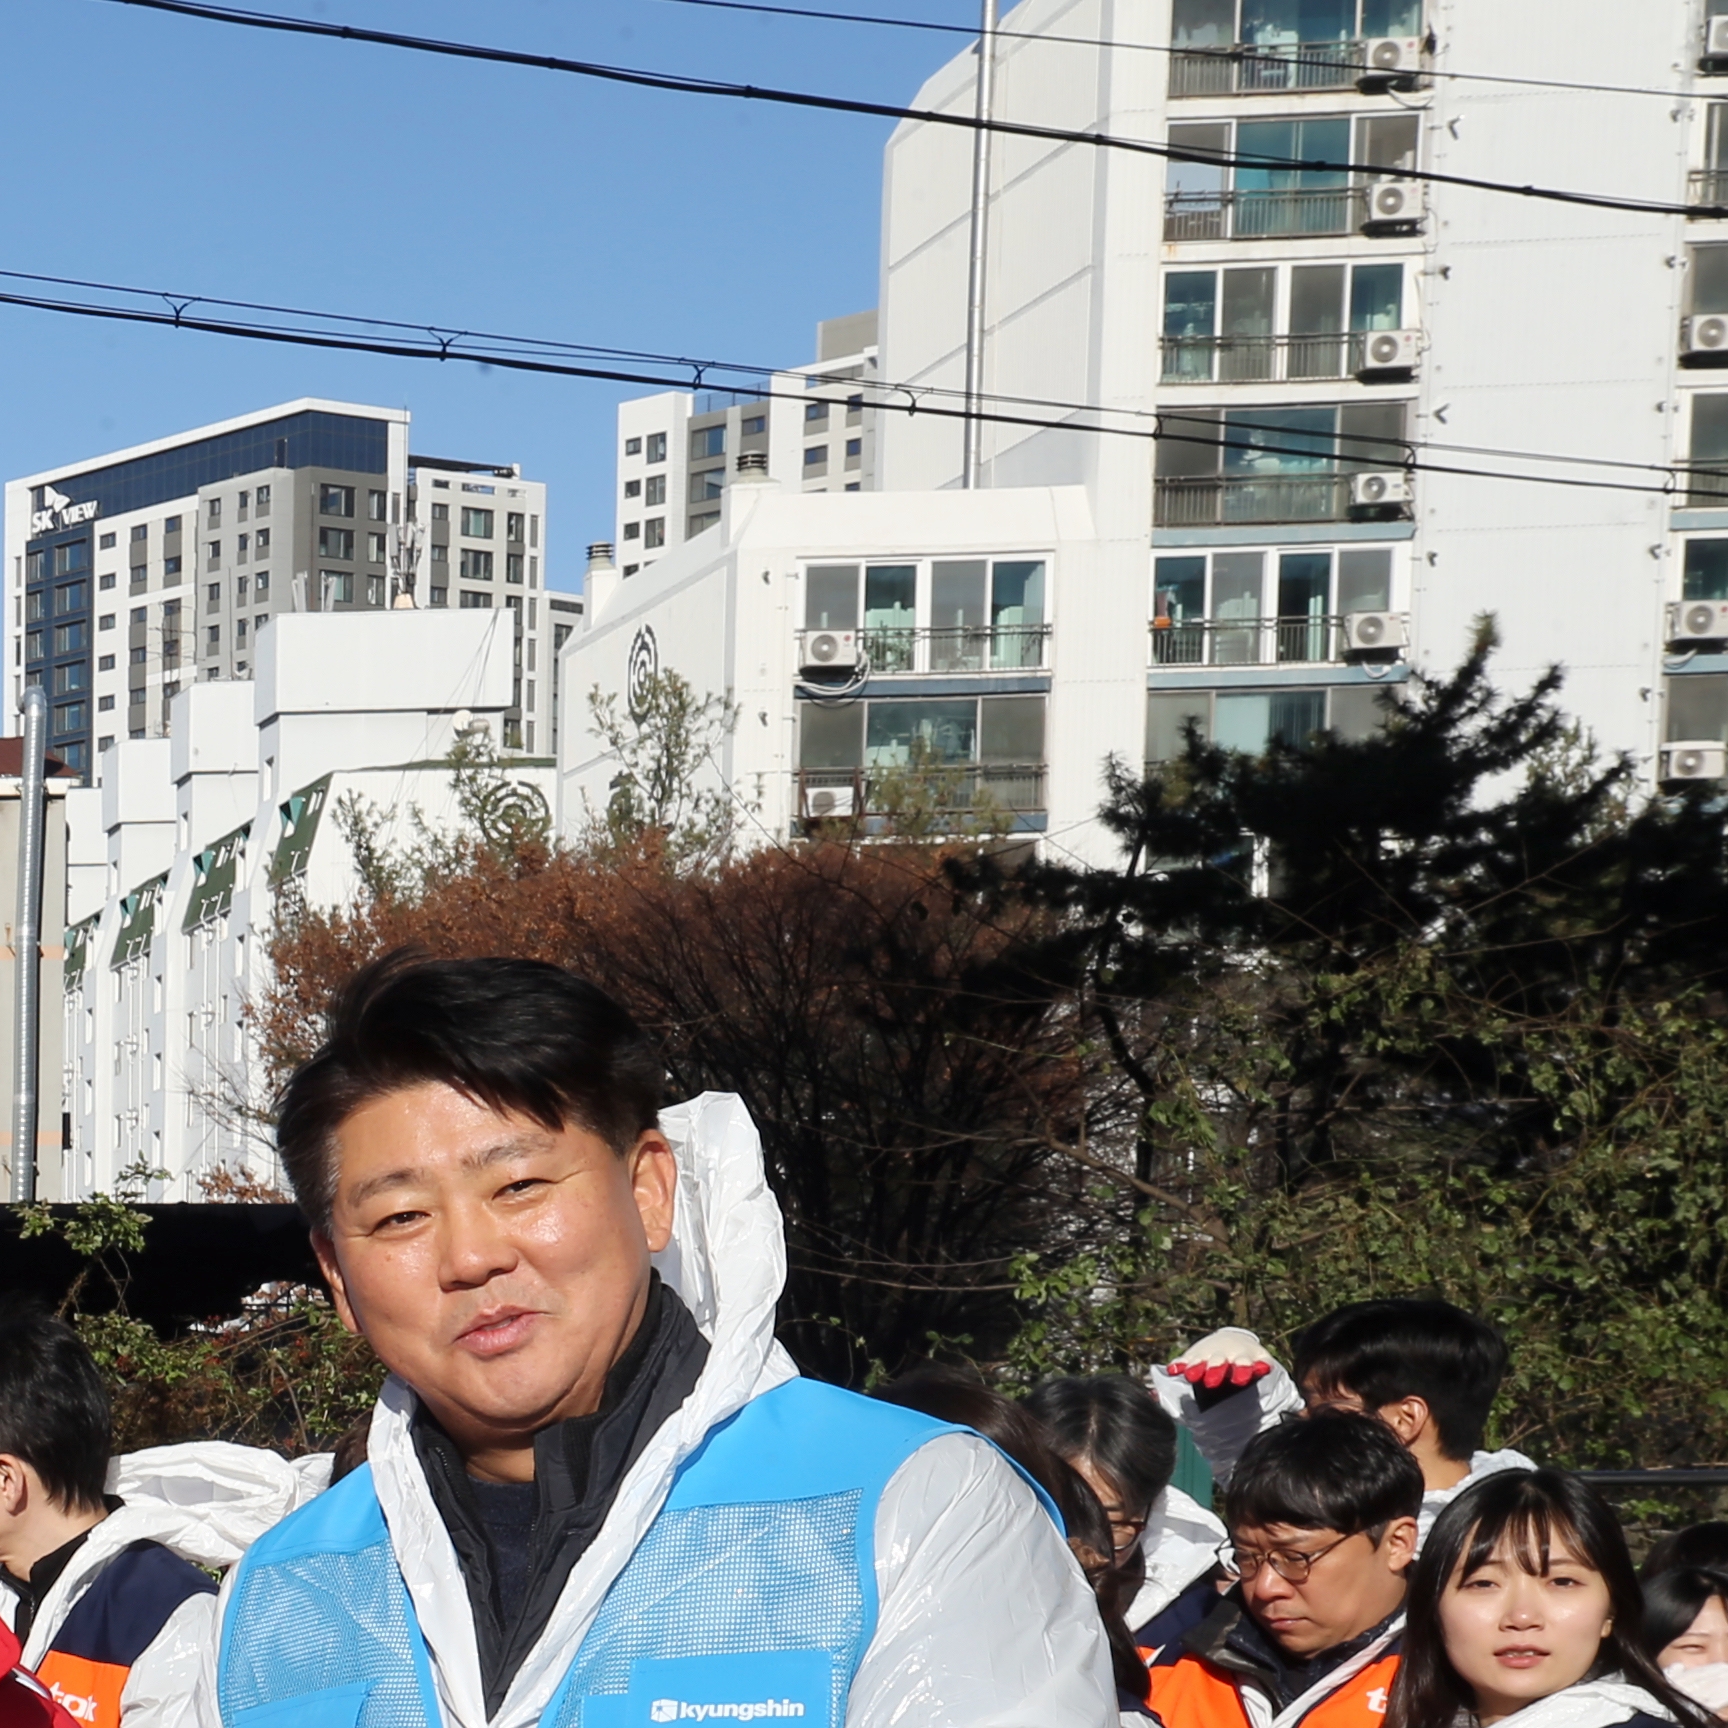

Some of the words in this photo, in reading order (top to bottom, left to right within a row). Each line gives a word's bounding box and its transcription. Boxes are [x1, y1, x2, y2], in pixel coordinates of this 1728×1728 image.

[32, 508, 56, 534] SK
[61, 499, 98, 525] VIEW
[679, 1698, 805, 1722] kyungshin
